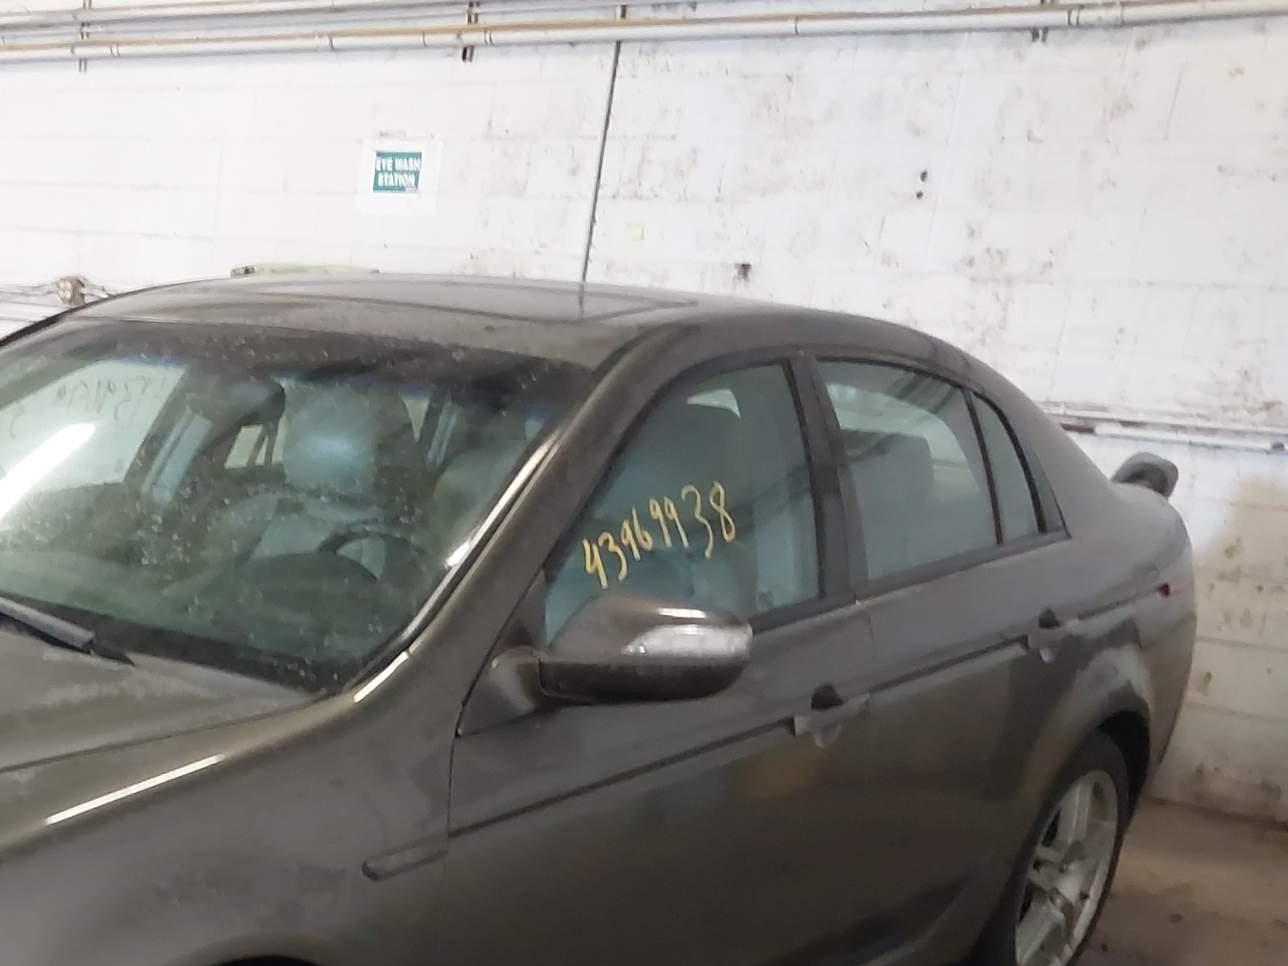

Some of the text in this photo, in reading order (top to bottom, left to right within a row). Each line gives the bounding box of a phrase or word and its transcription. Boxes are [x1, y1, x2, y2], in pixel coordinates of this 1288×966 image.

[375, 157, 421, 171] EYE WASH
[377, 172, 416, 187] STATION
[583, 480, 737, 589] 43969938
